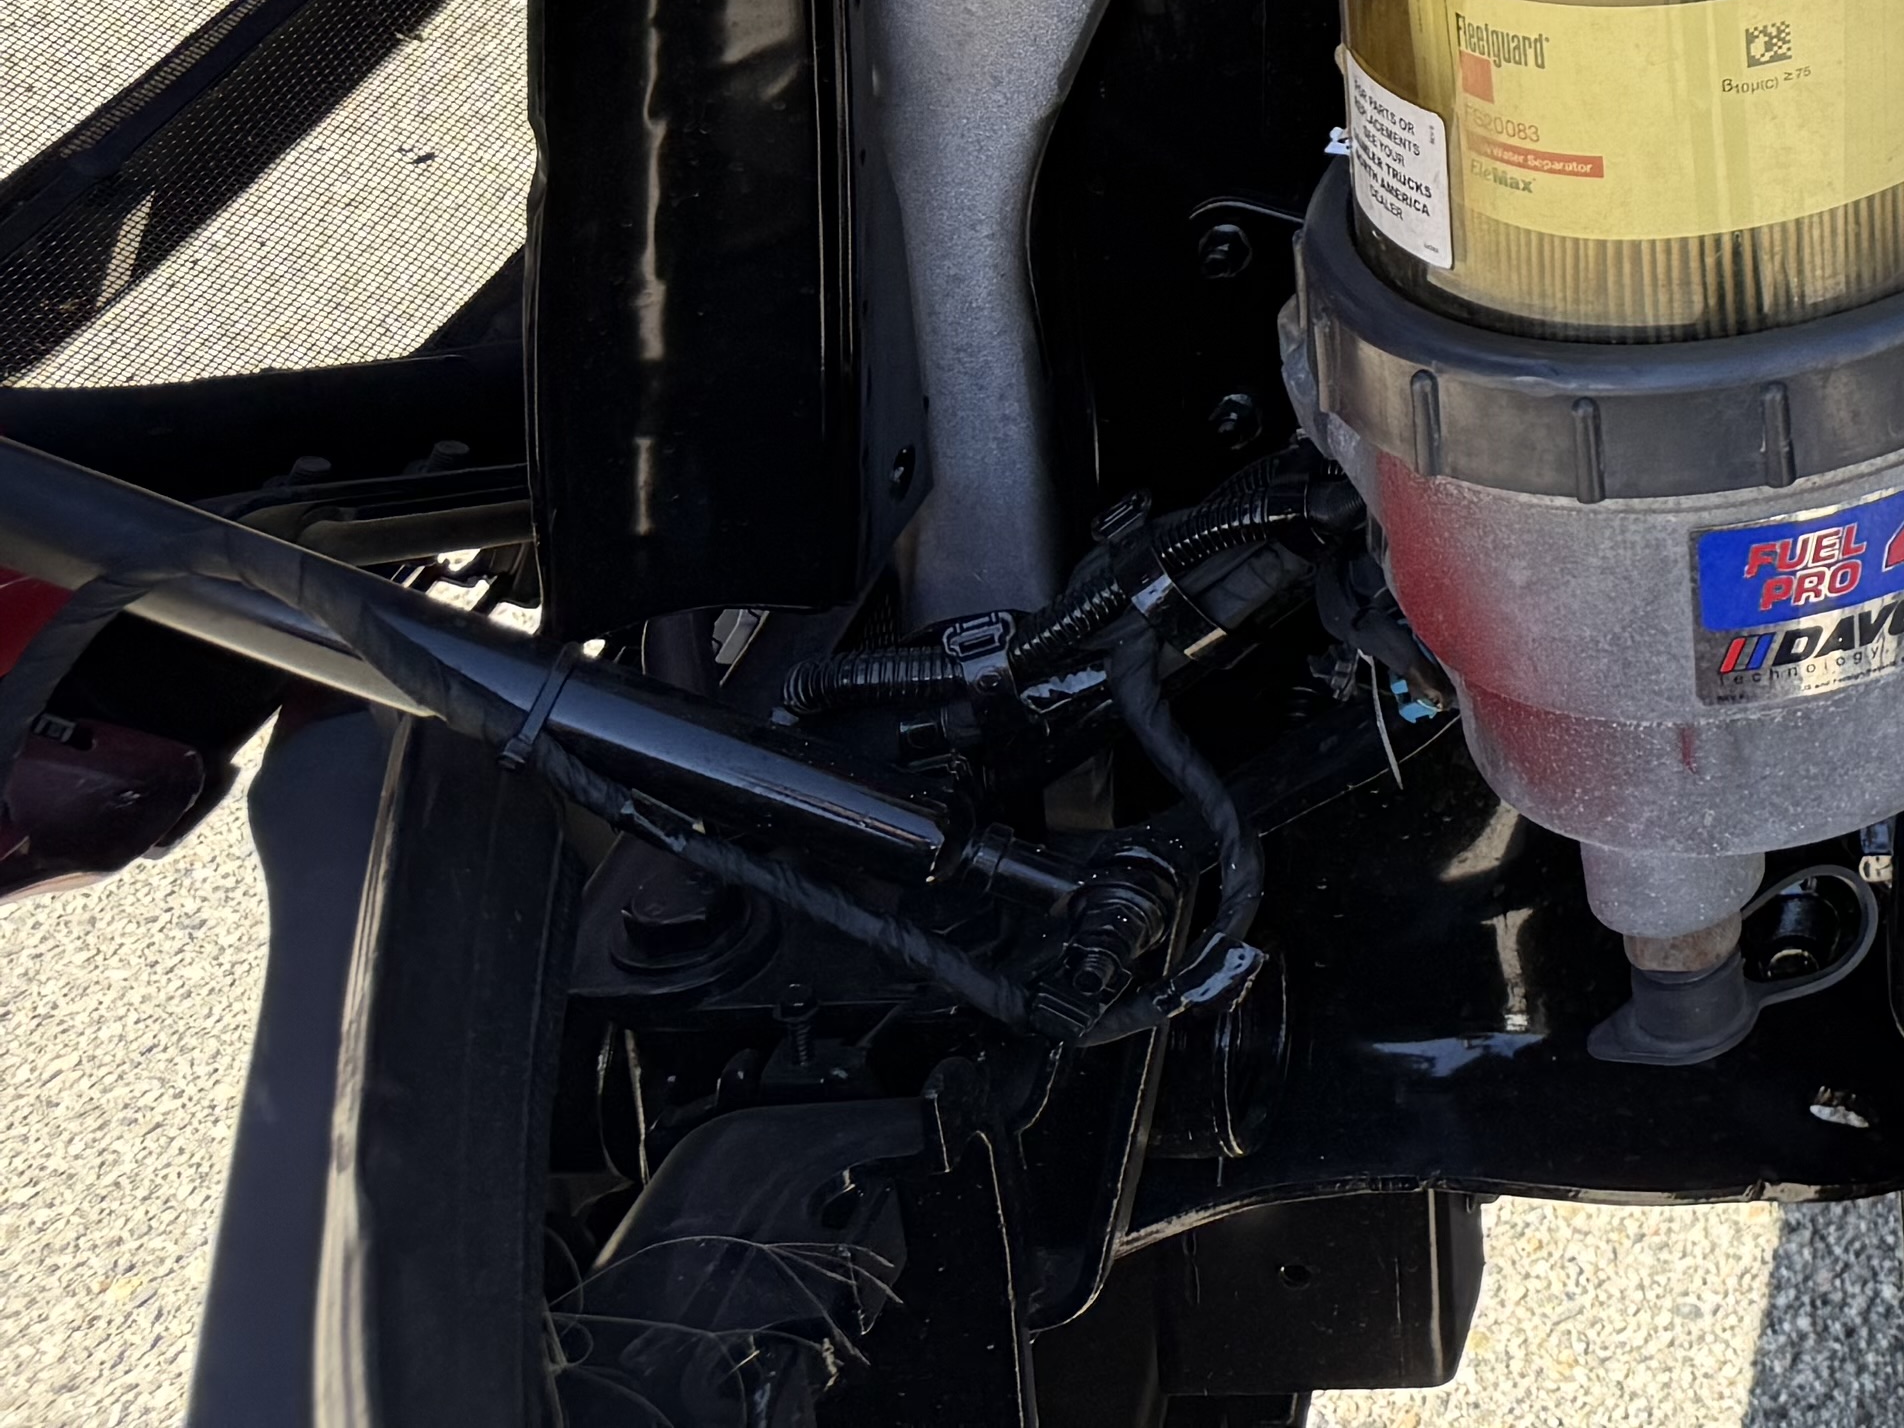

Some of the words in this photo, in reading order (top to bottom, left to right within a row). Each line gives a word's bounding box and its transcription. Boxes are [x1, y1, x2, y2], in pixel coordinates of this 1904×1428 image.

[1368, 94, 1397, 126] PARTS
[1399, 118, 1415, 136] OR
[1363, 125, 1379, 151] SEE
[1379, 138, 1405, 169] YOUR
[1527, 152, 1593, 174] Separator
[1380, 176, 1430, 217] AMERICA
[1385, 158, 1432, 199] TRUCKS
[1370, 184, 1403, 221] DEALER
[1743, 522, 1868, 579] FUEL
[1759, 558, 1862, 613] PRO
